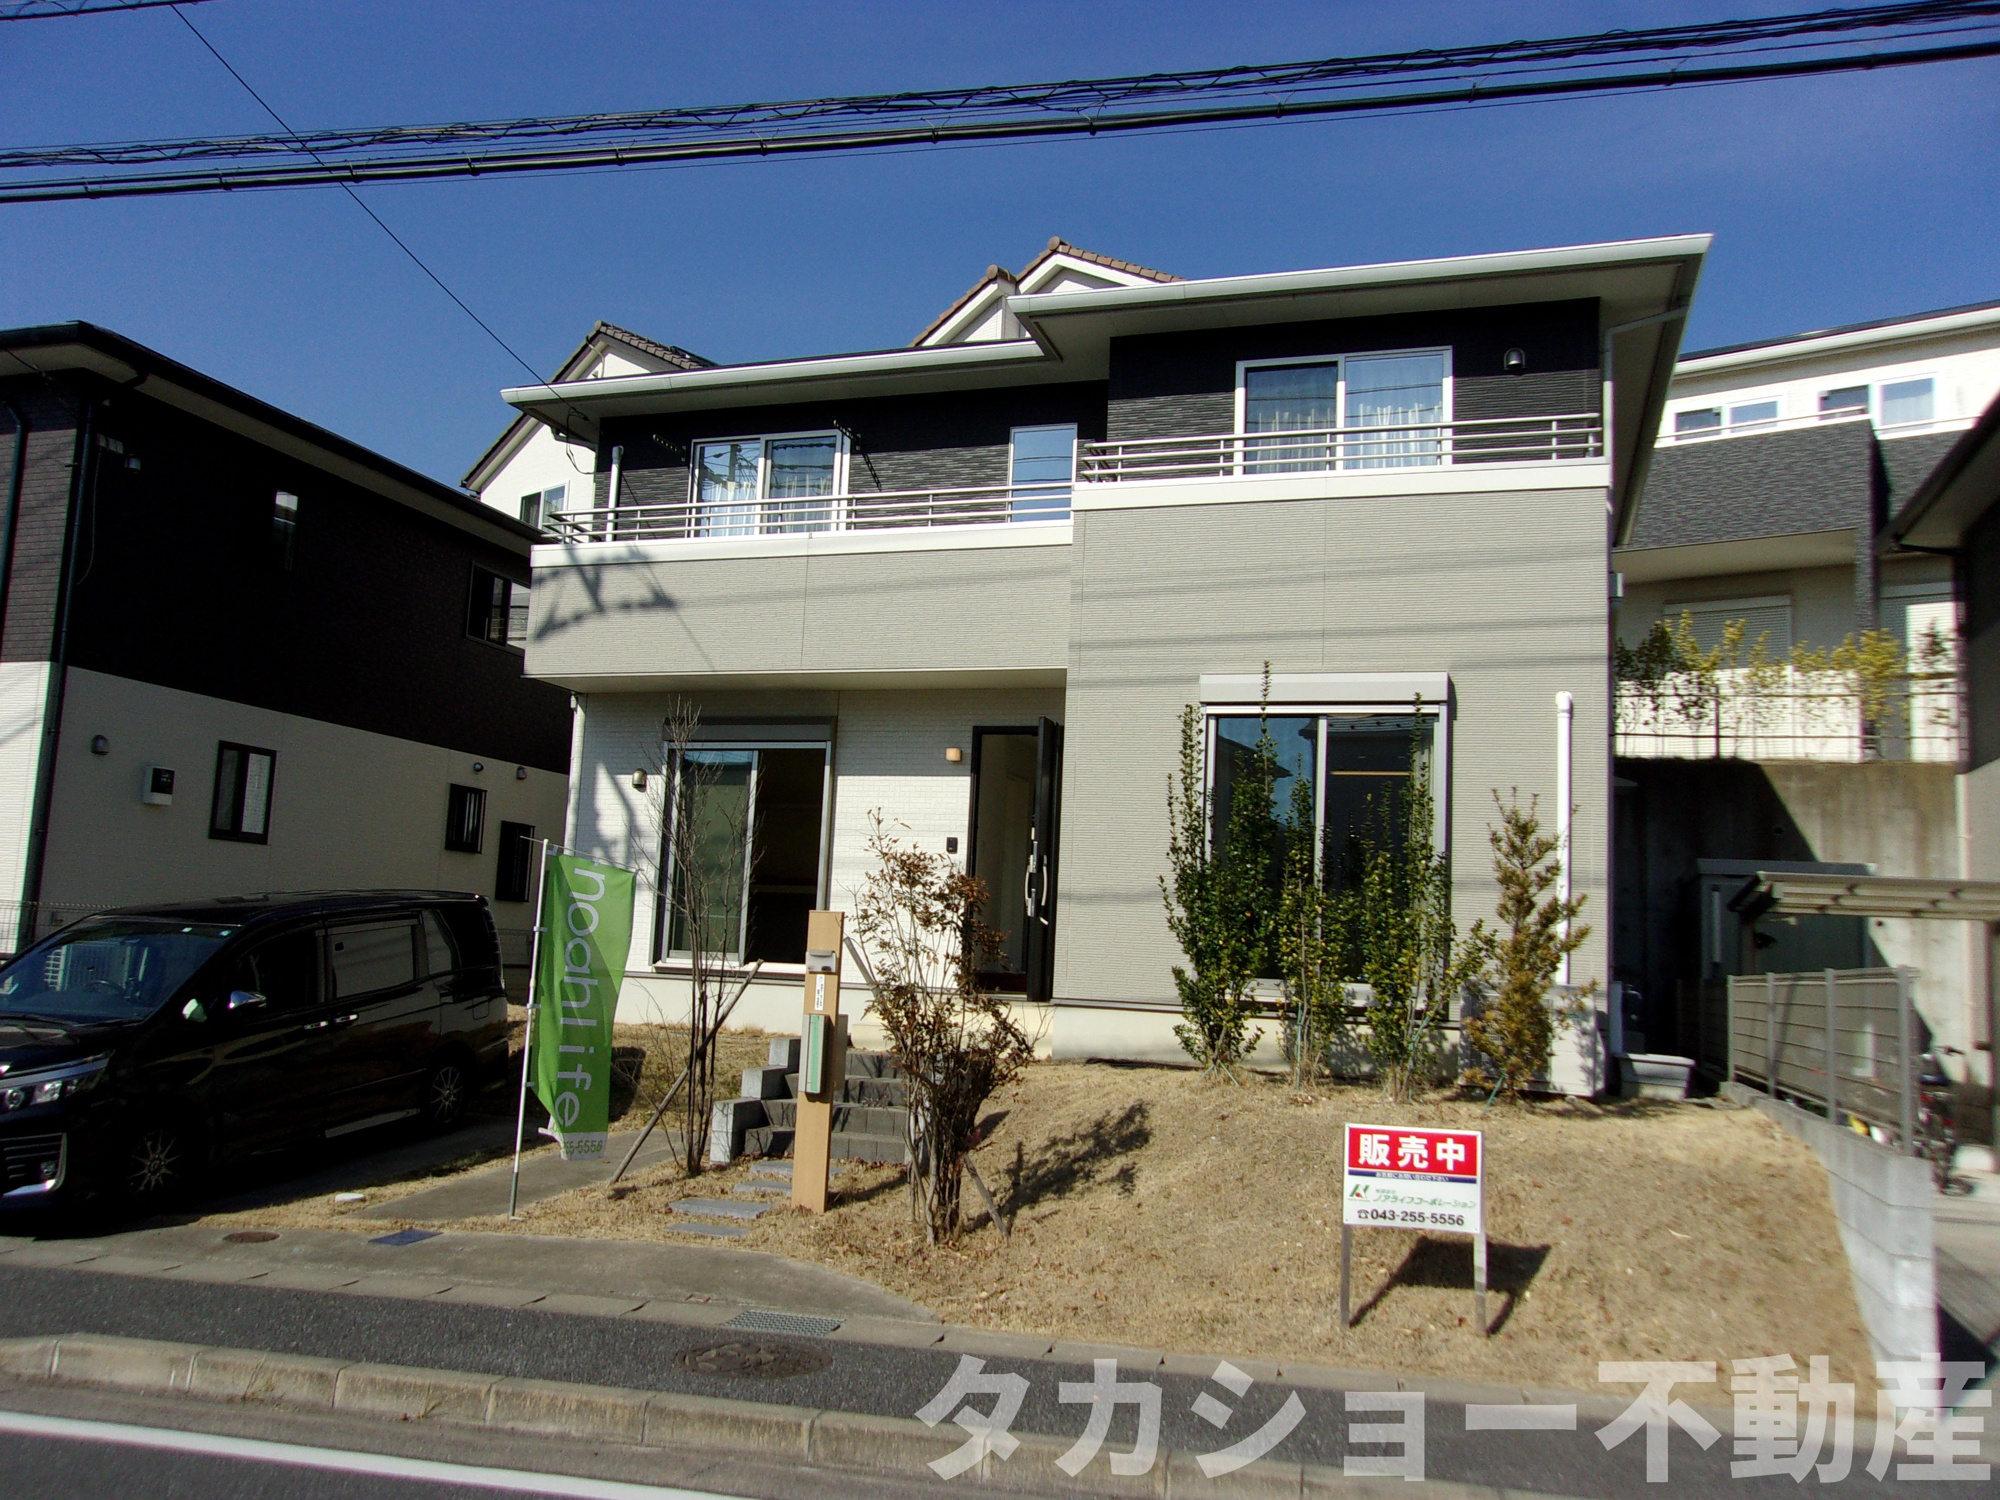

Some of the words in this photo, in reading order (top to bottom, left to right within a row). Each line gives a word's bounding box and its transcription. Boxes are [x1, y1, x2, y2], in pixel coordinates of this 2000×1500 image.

[1358, 1133, 1465, 1171] 販売中
[1370, 1209, 1465, 1226] 043-255-5556
